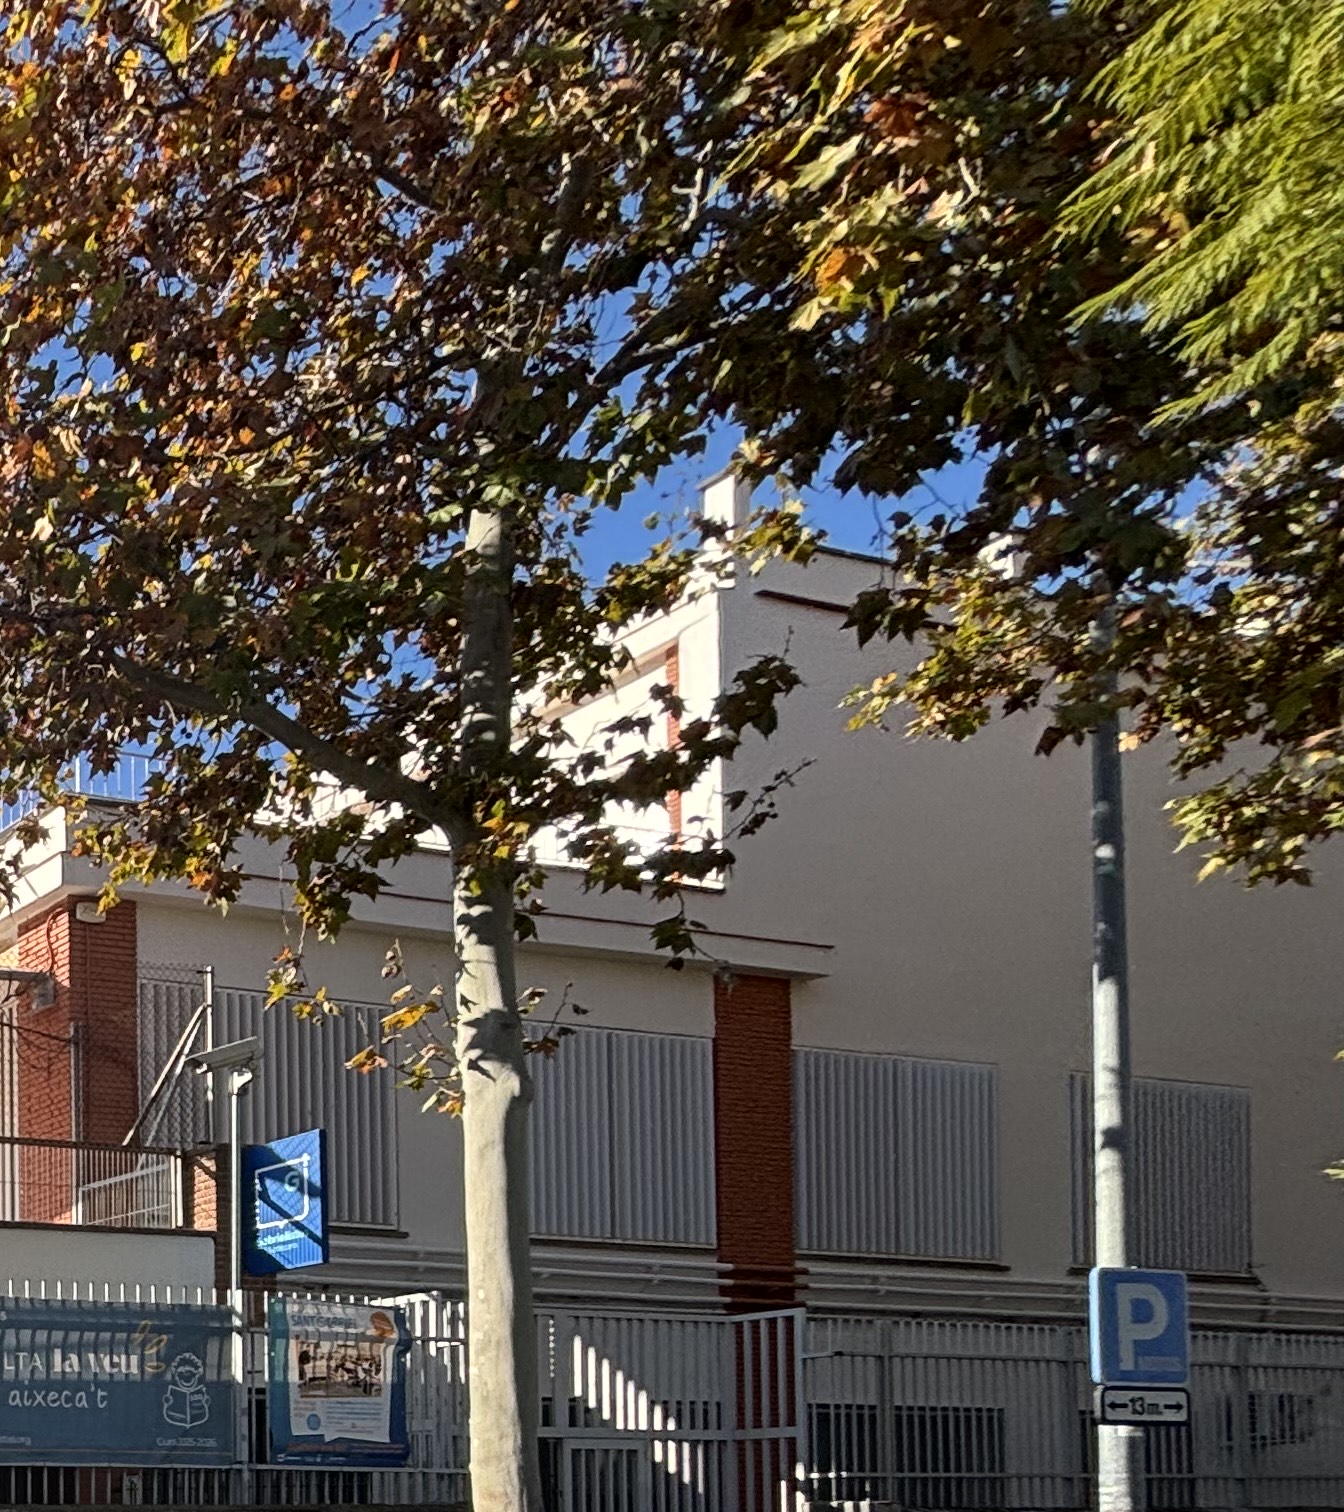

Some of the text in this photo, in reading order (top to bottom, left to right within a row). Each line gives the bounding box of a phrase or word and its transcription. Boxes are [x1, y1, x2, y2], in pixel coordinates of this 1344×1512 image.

[284, 1170, 300, 1192] G
[1116, 1282, 1169, 1371] P
[53, 1347, 81, 1373] la
[87, 1352, 139, 1375] veu
[8, 1379, 108, 1409] aixeca't
